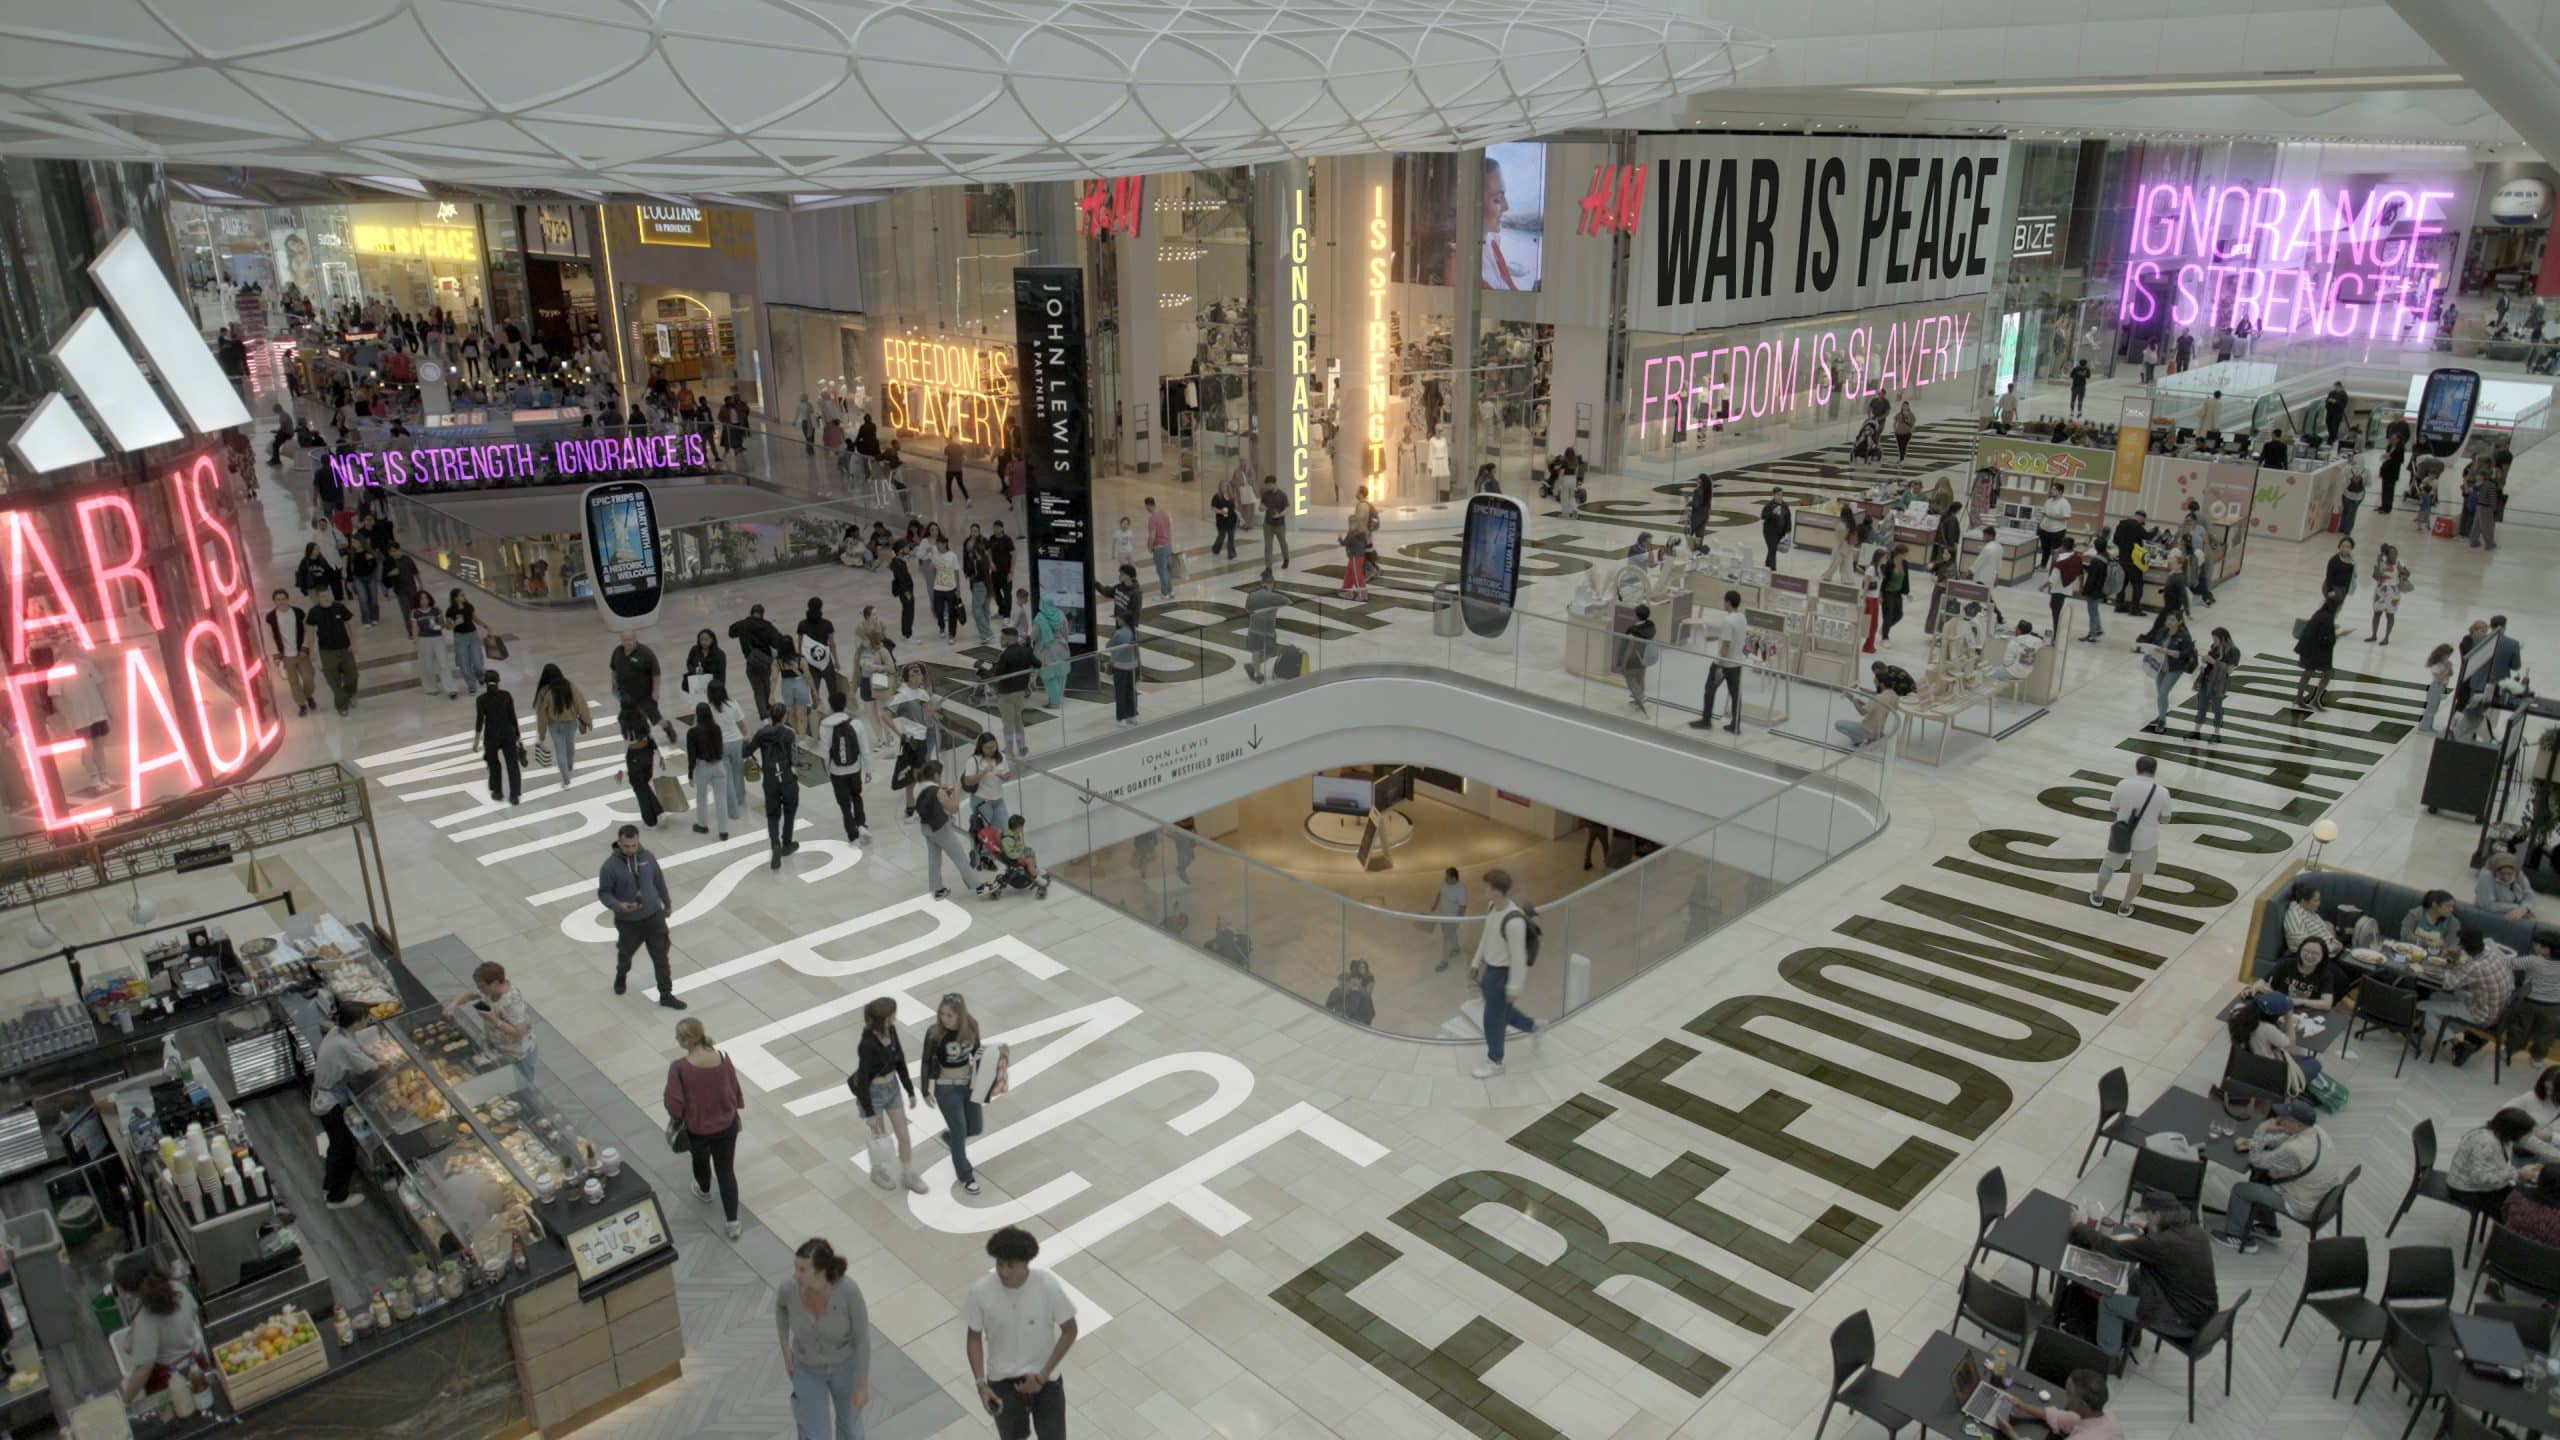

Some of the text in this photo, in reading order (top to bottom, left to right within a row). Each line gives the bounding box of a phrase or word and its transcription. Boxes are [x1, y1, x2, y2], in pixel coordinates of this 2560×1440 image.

[1577, 163, 1648, 238] H&M
[1657, 156, 1999, 307] WAR IS PEACE
[2013, 223, 2056, 250] BIZE
[2129, 183, 2455, 270] IGNORANCE
[411, 227, 477, 261] PEACE
[1043, 284, 1065, 366] JOHN
[2119, 260, 2441, 345] IS STRENGTH
[883, 338, 1009, 394] FREEDOM IS
[1291, 189, 1308, 517] IGNORANCE
[1368, 185, 1387, 503] IS STRENGTH
[1640, 311, 1971, 440] FREEDOM IS SLAVERY
[888, 379, 1010, 449] SLAVERY
[1034, 352, 1045, 418] PARTNERS
[382, 451, 407, 485] IS
[411, 444, 534, 483] STRENGTH
[555, 435, 680, 474] IGNORANCE
[684, 433, 705, 466] IS
[1050, 380, 1070, 472] LEWIS
[173, 455, 240, 609] IS
[591, 492, 635, 507] EPIC TRIPS
[636, 501, 650, 549] START WITH
[609, 561, 645, 573] HISTORIC
[617, 566, 656, 581] WELCOME
[1127, 774, 1162, 794] QUARTER
[1171, 757, 1212, 779] WESTFIELD
[1216, 747, 1243, 764] SQUARE
[1141, 737, 1209, 767] JOHN LEWIS
[643, 893, 1391, 1341] PEACE
[1267, 884, 2168, 1440] FREEDOM
[1933, 829, 2239, 934] IS
